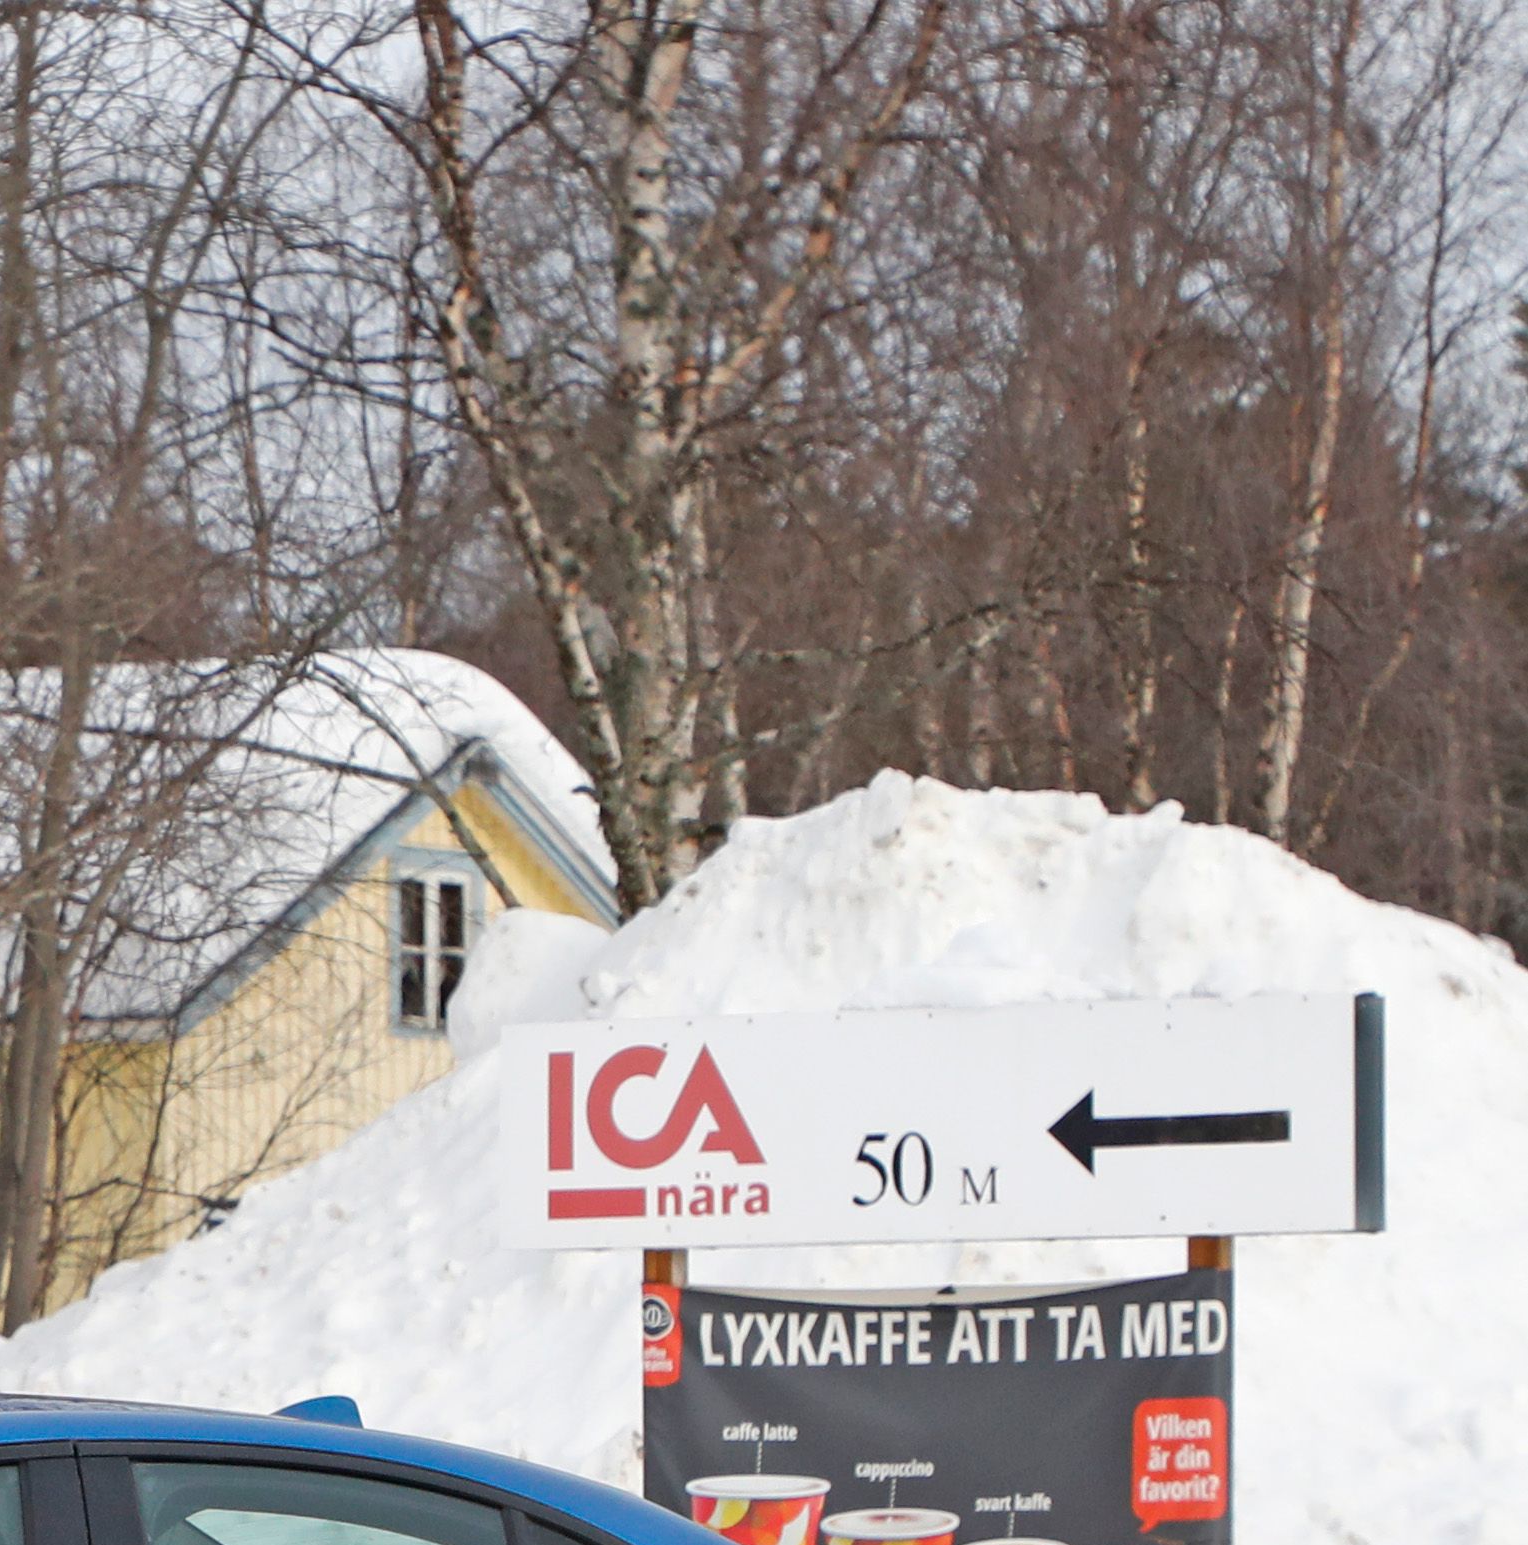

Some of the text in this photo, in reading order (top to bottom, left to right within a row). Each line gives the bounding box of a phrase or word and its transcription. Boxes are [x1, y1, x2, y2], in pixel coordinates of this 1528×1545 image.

[548, 1043, 767, 1171] ICA
[852, 1131, 999, 1206] 50 M
[657, 1172, 771, 1217] nära
[700, 1299, 1228, 1367] LYXKAFFE ATT TA MED
[722, 1422, 798, 1442] caffe latte
[1146, 1413, 1212, 1439] Vilken
[855, 1459, 935, 1482] cappuccino
[1147, 1443, 1211, 1472] är din
[975, 1492, 1052, 1512] svart kaffe
[1140, 1474, 1220, 1503] favorit?
